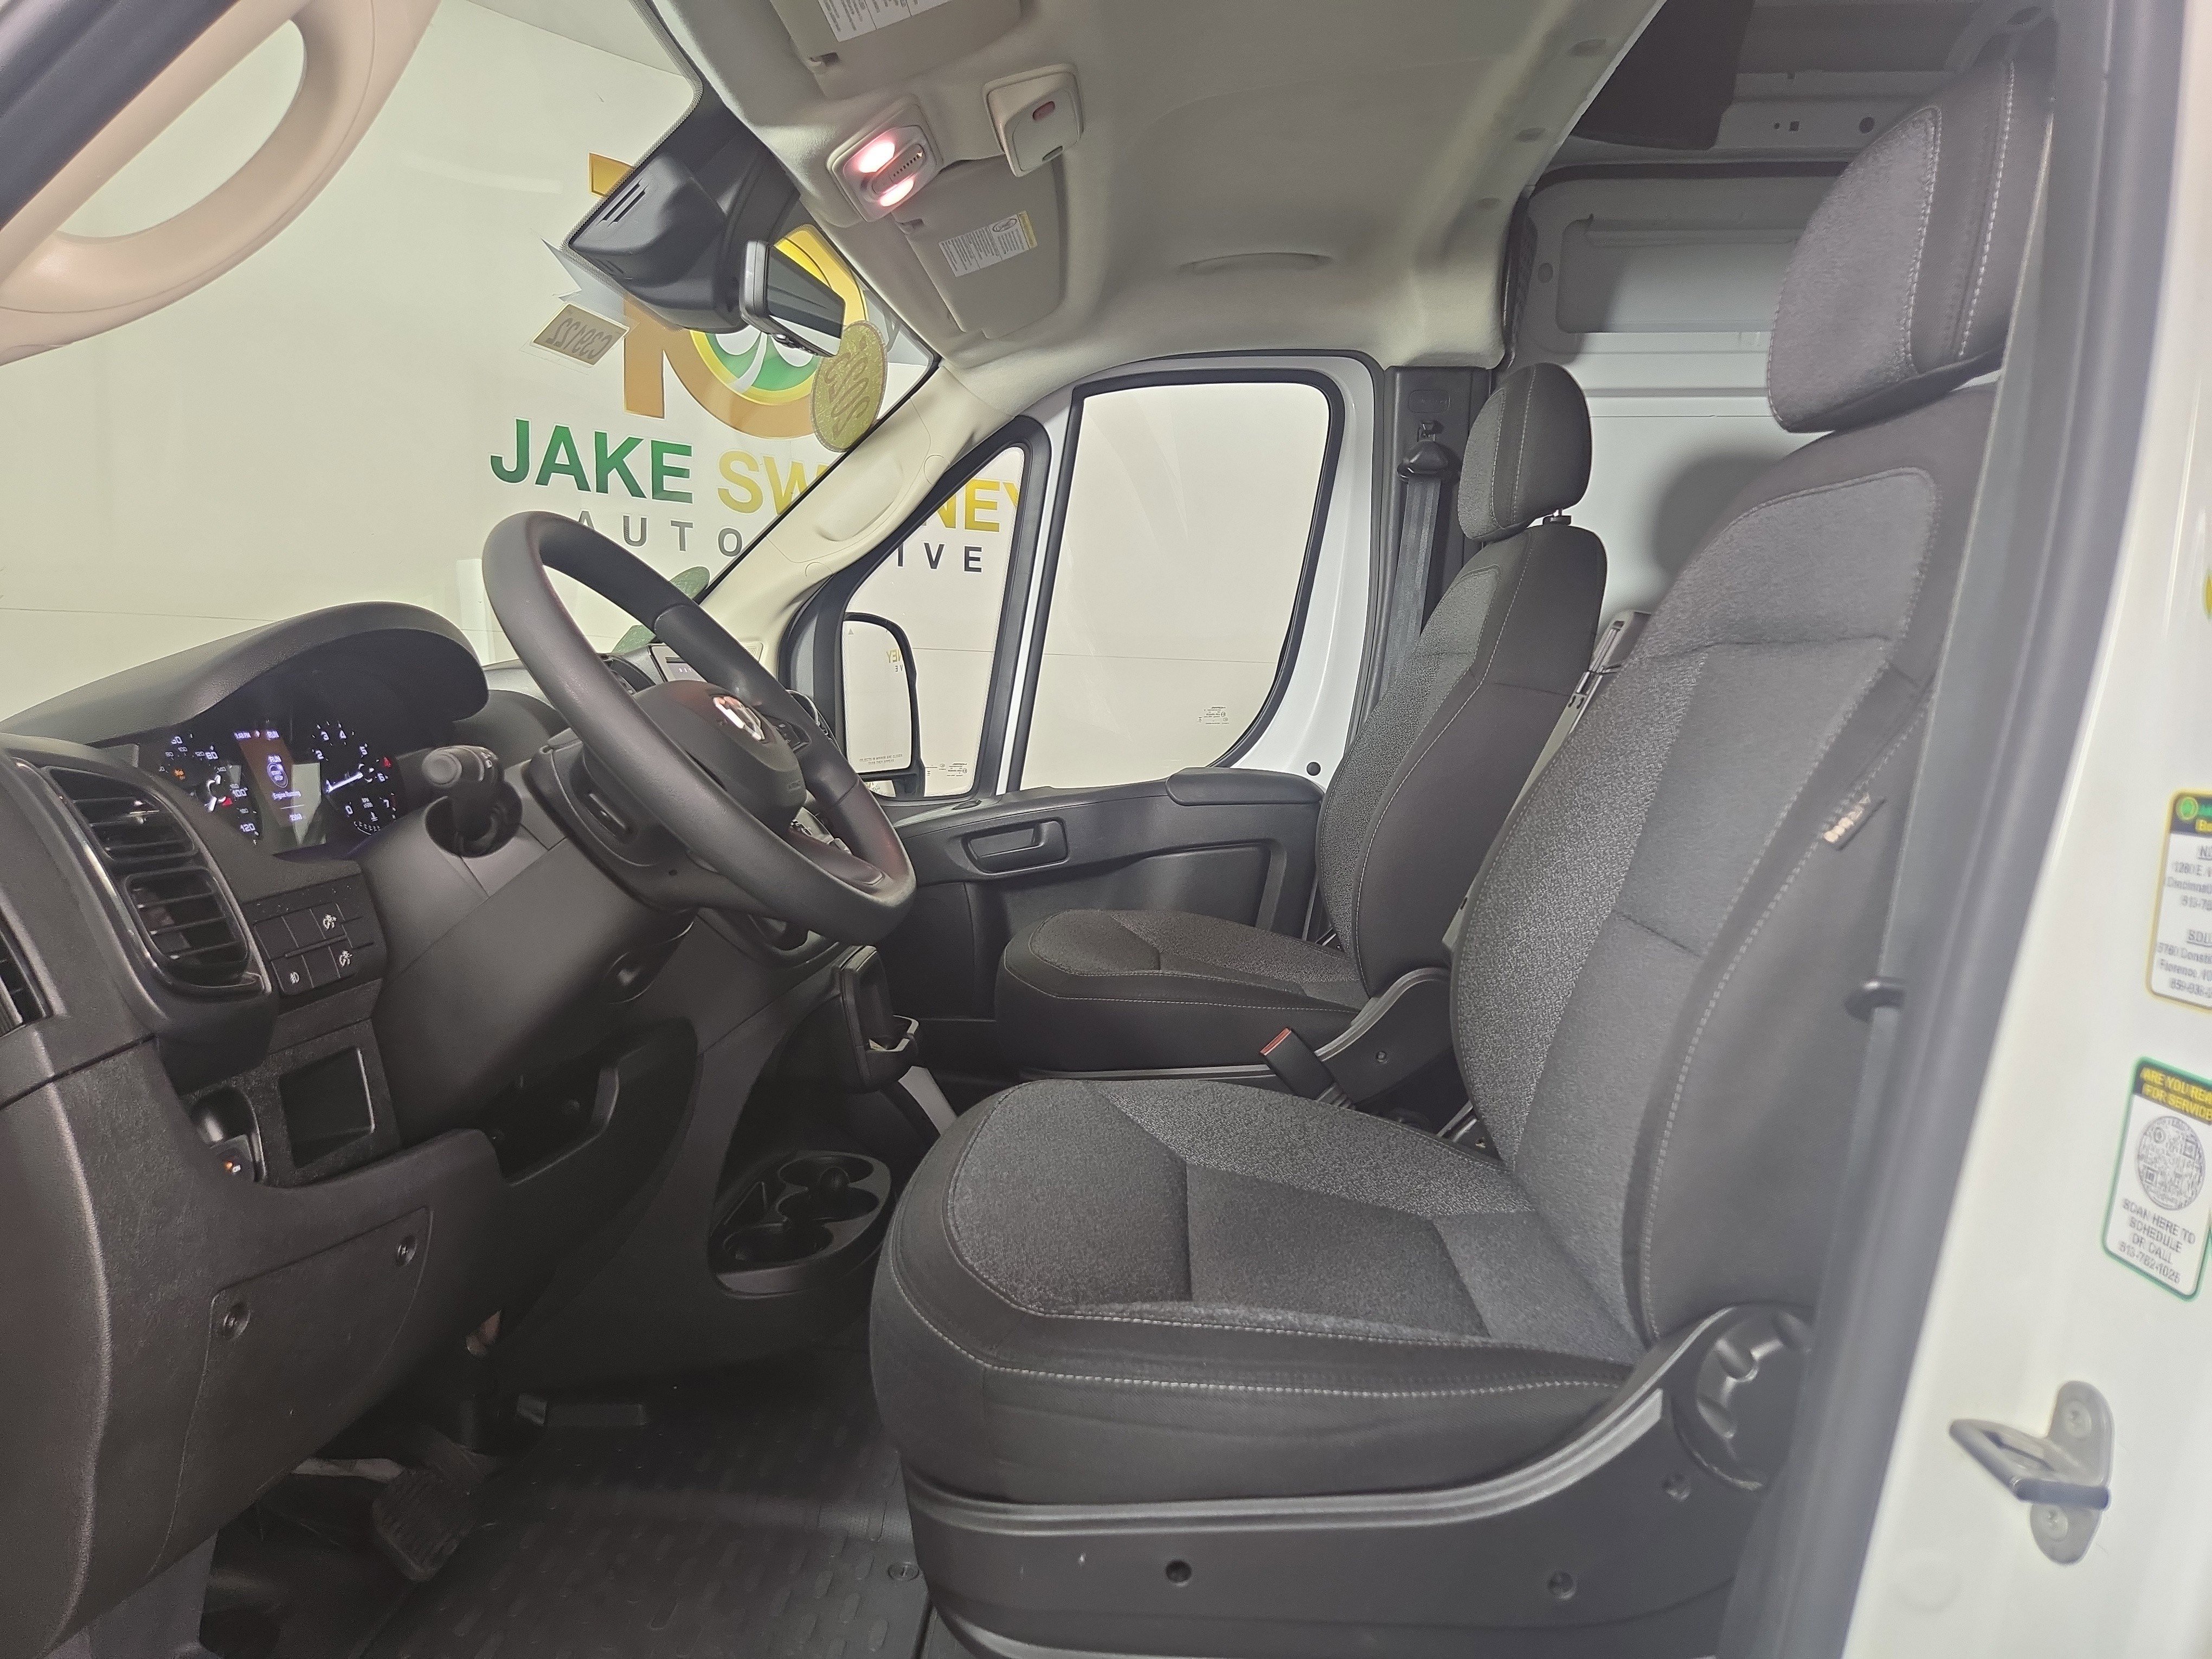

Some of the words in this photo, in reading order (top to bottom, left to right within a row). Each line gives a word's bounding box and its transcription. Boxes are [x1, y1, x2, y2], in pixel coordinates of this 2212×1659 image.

[490, 418, 693, 504] JAKE
[268, 755, 281, 763] RUN
[240, 823, 255, 832] 120
[2123, 1198, 2151, 1220] SCAN
[2153, 1213, 2179, 1237] HERE
[2182, 1228, 2196, 1245] TO
[2129, 1216, 2183, 1253] SCHEDULE
[2149, 1242, 2172, 1264] CALL
